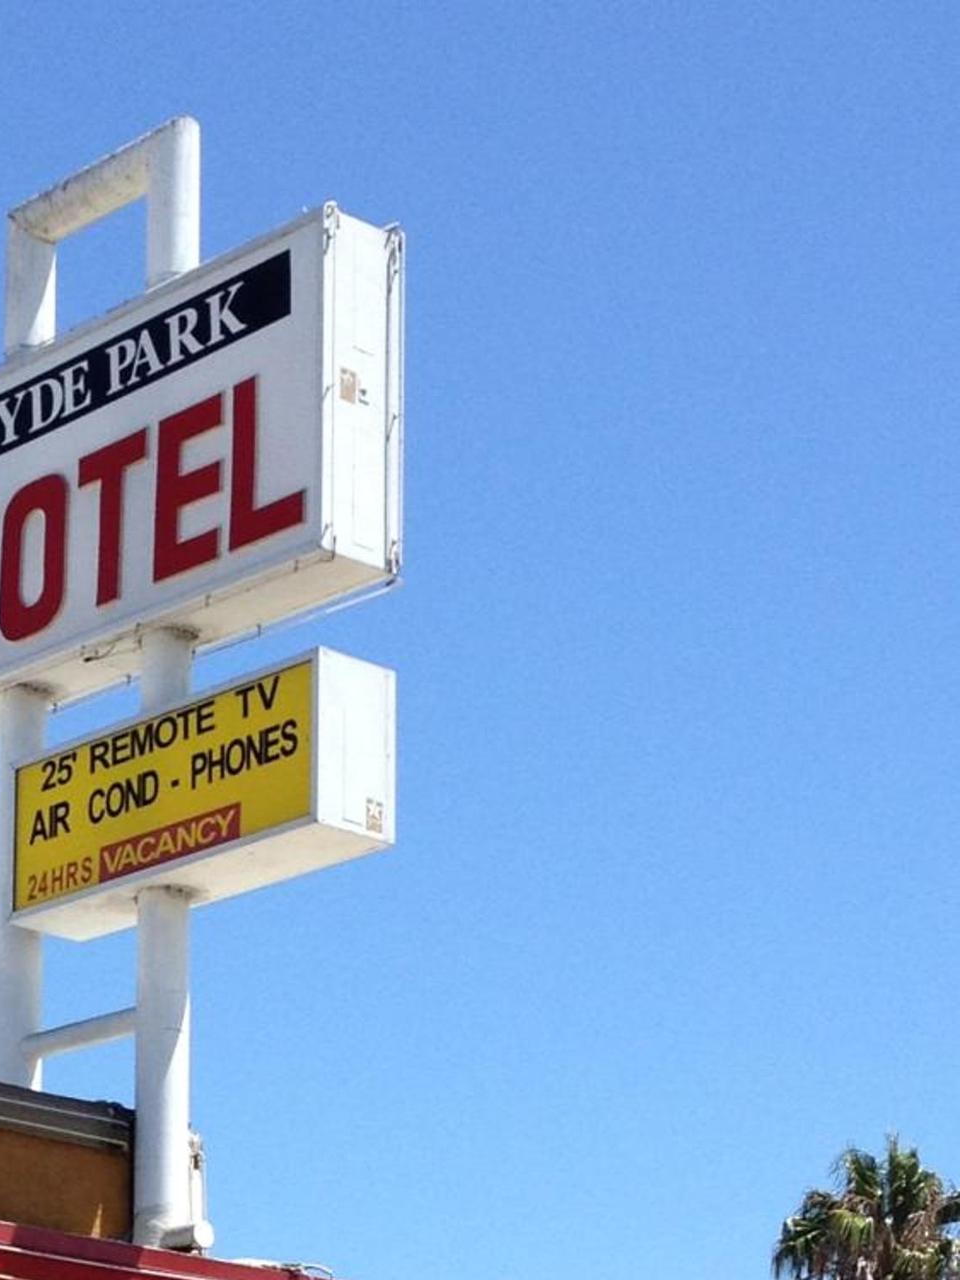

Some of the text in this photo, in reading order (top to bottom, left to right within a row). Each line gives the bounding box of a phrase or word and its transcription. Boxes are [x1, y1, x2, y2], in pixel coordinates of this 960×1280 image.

[105, 281, 248, 385] PARK
[88, 700, 216, 774] REMOTE
[235, 675, 280, 718] TV
[29, 800, 71, 845] AIR
[88, 770, 159, 825] COND
[190, 718, 299, 790] PHONES
[26, 808, 238, 900] 24HRS VACANCY
